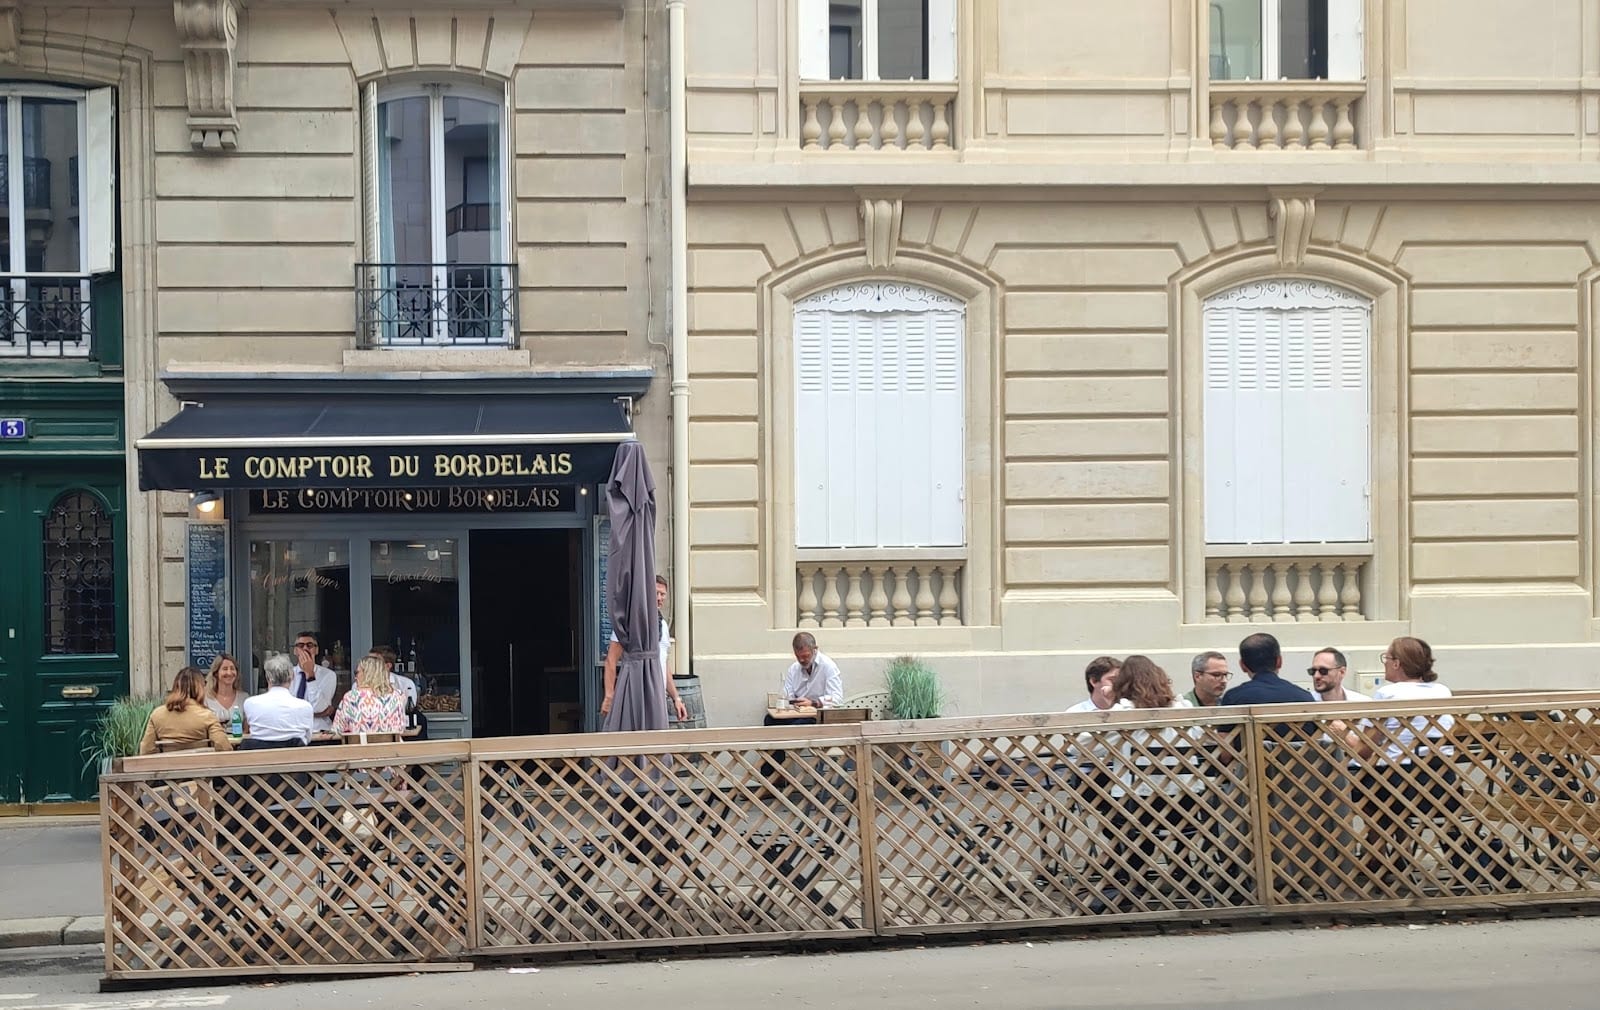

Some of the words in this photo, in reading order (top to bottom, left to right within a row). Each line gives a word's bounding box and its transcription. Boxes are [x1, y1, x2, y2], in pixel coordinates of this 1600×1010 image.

[7, 421, 18, 436] 3
[200, 457, 230, 479] LE
[244, 455, 374, 478] COMPTOIR
[389, 455, 420, 477] DU
[434, 453, 573, 477] BORDELAIS
